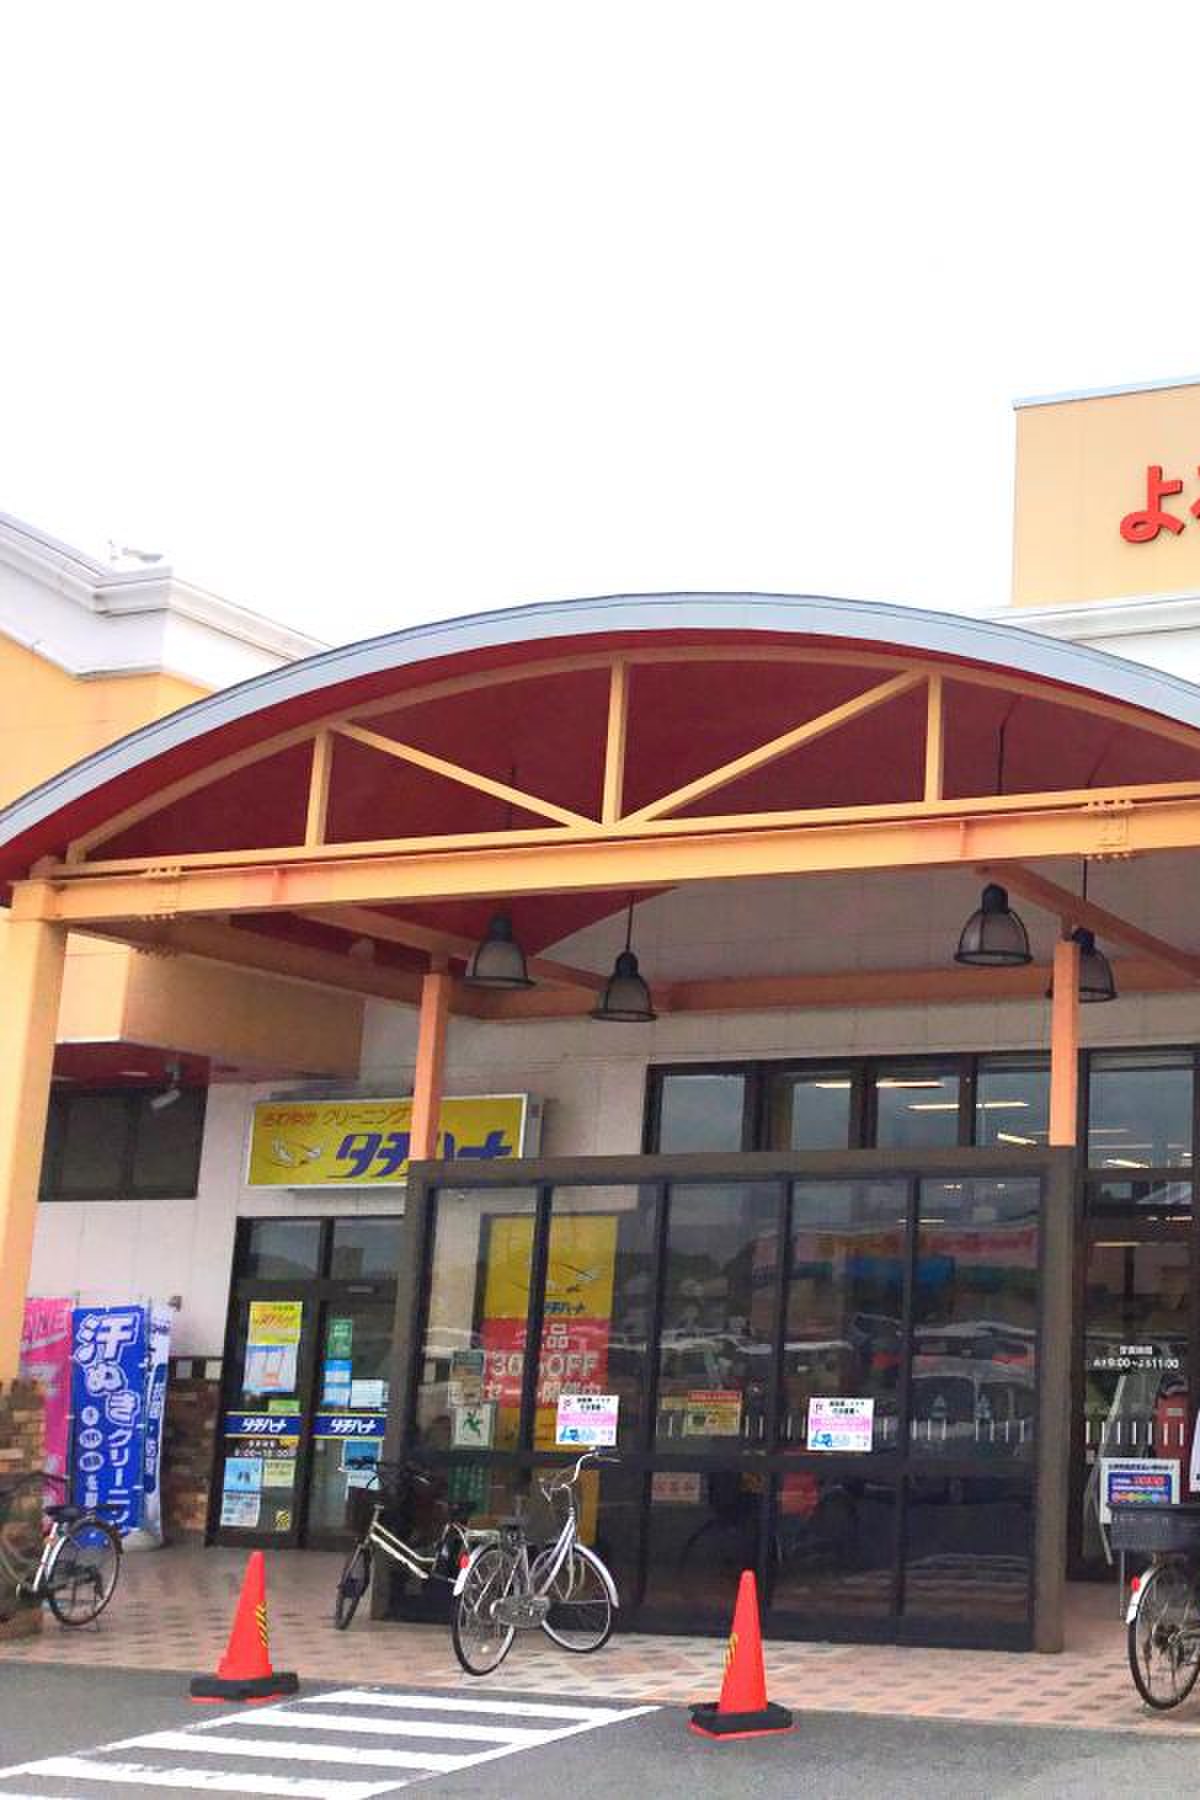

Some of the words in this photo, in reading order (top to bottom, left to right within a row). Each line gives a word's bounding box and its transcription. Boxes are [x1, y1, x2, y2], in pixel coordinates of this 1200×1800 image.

[72, 1312, 141, 1535] 汗ぬきクリーニン
[490, 1351, 599, 1377] 30OFF
